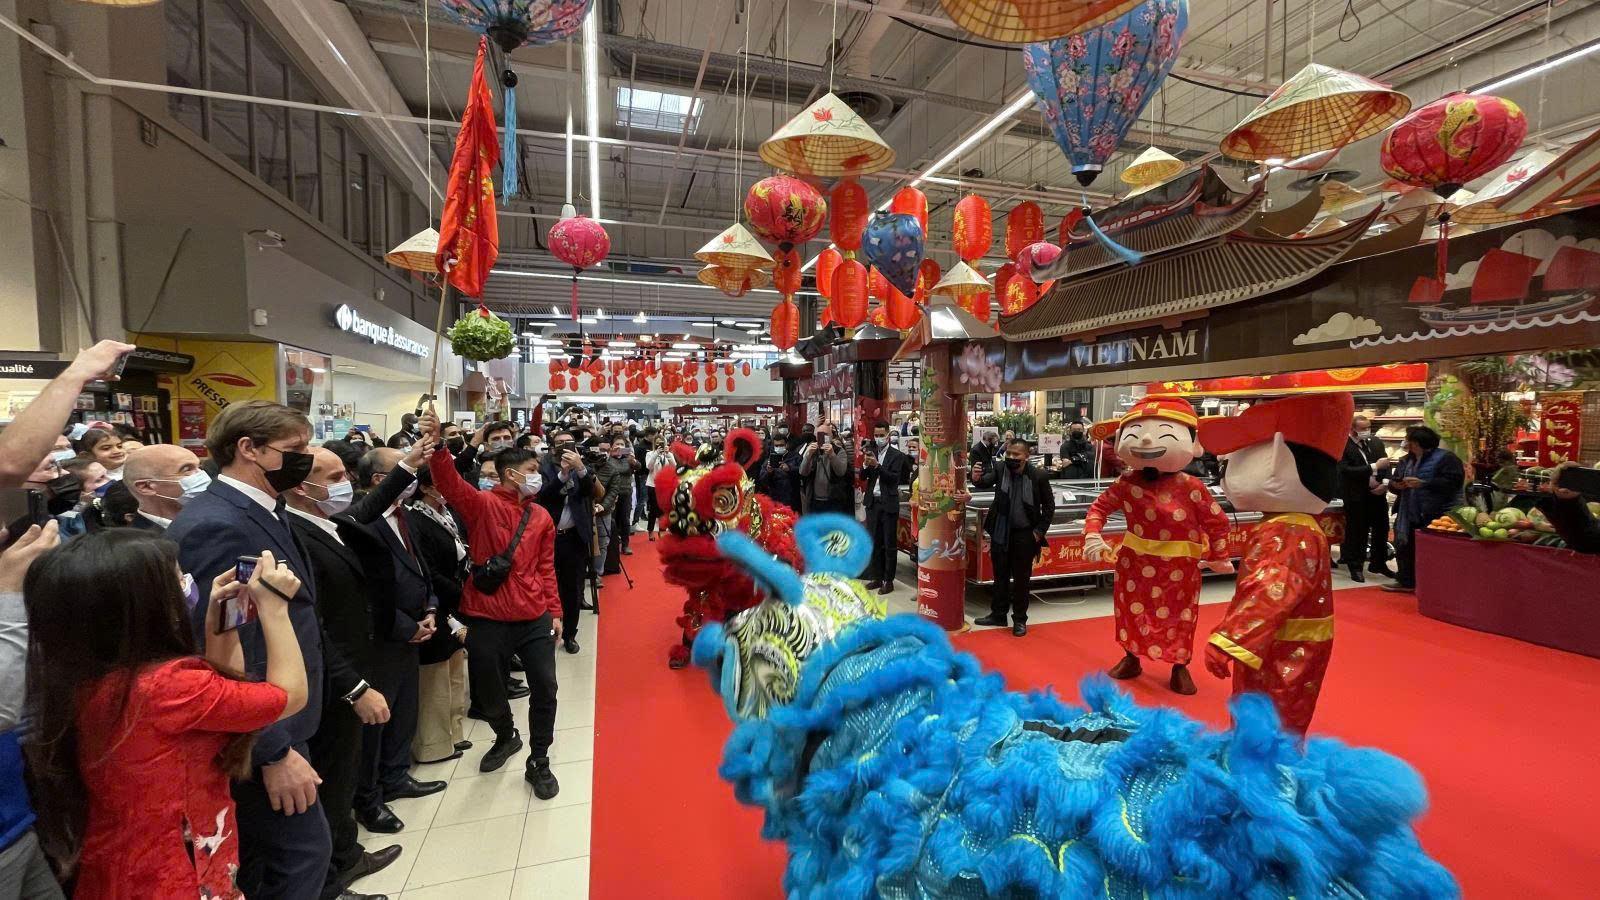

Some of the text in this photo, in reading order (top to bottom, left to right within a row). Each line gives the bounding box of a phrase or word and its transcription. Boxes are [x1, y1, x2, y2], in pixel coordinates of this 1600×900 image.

[352, 309, 388, 345] banque
[394, 333, 429, 359] assurances
[1072, 329, 1199, 368] VIETNAM
[976, 400, 993, 410] celi
